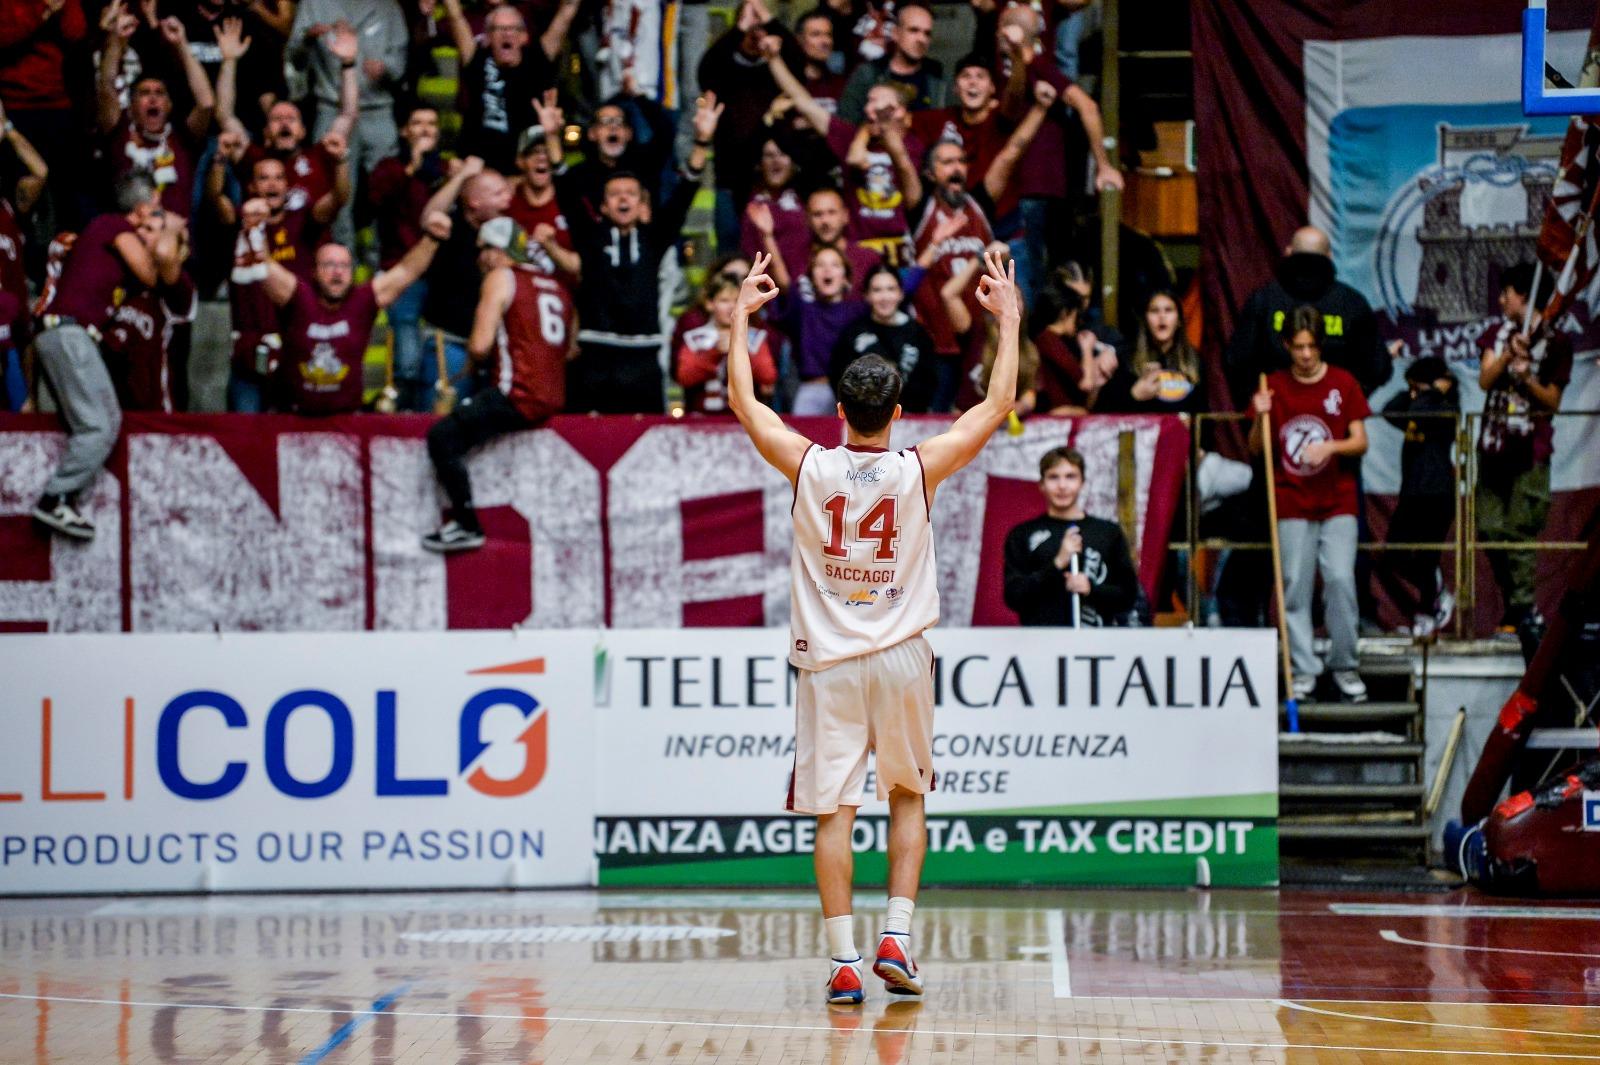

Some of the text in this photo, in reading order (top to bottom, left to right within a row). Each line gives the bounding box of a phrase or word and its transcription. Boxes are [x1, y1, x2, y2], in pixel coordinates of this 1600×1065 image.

[537, 293, 566, 346] 6
[821, 491, 901, 563] 14
[825, 564, 895, 583] SACCAGGI
[625, 655, 1261, 709] TELEICA ITALIA
[932, 734, 1128, 758] CONSULENZA
[2, 829, 546, 866] PRODUCTS OUR PASSION
[985, 827, 1008, 853] e
[1016, 819, 1097, 853] TAX
[1106, 820, 1254, 855] CREDIT
